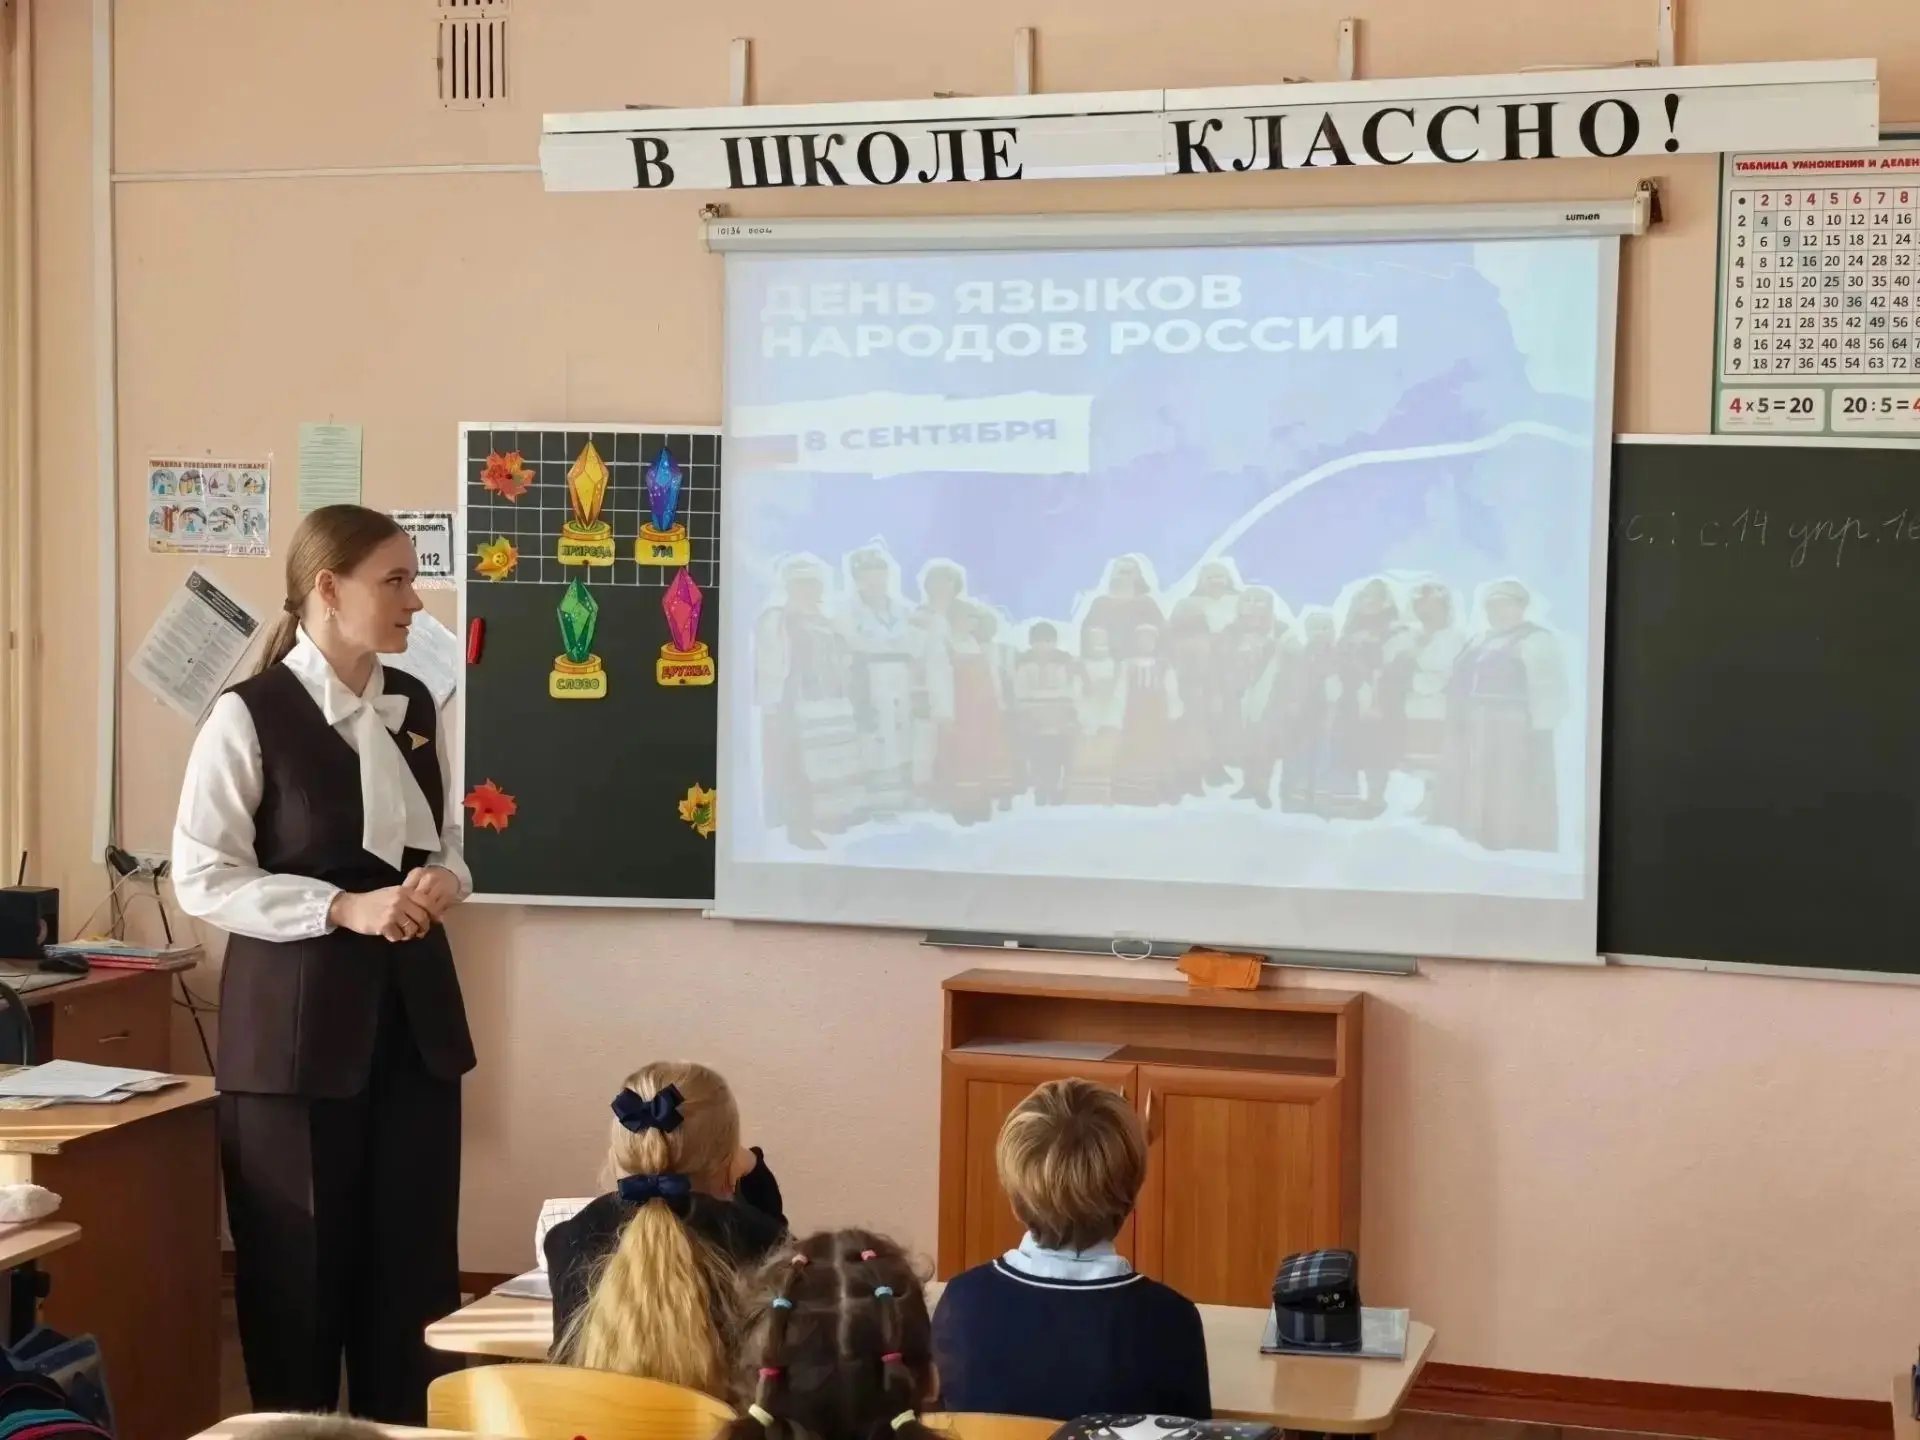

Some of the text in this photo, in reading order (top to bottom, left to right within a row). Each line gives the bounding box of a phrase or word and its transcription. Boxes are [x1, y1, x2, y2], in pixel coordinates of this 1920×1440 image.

[626, 92, 1682, 190] В ШКОЛЕ КЛАССНО!
[1735, 161, 1789, 171] ТАБЛИЦА
[1792, 159, 1865, 169] УМНОЖЕНИЯ
[1868, 159, 1877, 168] И
[1760, 190, 1909, 207] 2 3 4 5 6 7 8
[1737, 213, 1912, 227] 2 4 6 8 10 12 14 16
[1737, 233, 1911, 248] 3 6 9 12 15 18 21 24
[1735, 254, 1910, 269] 4 8 12 16 20 24 28 32
[1735, 275, 1910, 289] 5 10 15 20 25 30 35 40
[760, 274, 1243, 322] ДЕНЬ ЯЗЫКОВ
[1735, 295, 1909, 309] 6 12 18 24 30 36 42 48
[1735, 316, 1744, 330] 7
[1754, 318, 1769, 329] 14
[1776, 317, 1791, 329] 21
[1799, 317, 1815, 328] 28
[1822, 316, 1838, 328] 35
[1845, 316, 1862, 328] 42
[1869, 316, 1885, 328] 49
[1893, 316, 1908, 328] 56
[762, 314, 1399, 363] НАРОДОВ РОССИИ
[1733, 337, 1742, 350] 8
[1753, 338, 1769, 351] 16
[1775, 338, 1792, 350] 24
[1798, 338, 1814, 350] 32
[1821, 337, 1838, 349] 40
[1844, 337, 1861, 349] 48
[1868, 337, 1885, 350] 56
[1891, 337, 1908, 349] 64
[1732, 357, 1742, 370] 9
[1753, 358, 1768, 369] 18
[1775, 357, 1791, 369] 27
[1798, 357, 1814, 369] 36
[1821, 357, 1837, 369] 45
[1844, 357, 1860, 369] 54
[1868, 357, 1884, 369] 63
[1891, 357, 1907, 369] 72
[803, 418, 1059, 453] 8 СЕНТЯБРЯ
[416, 524, 446, 532] ЗВОНИТЬ
[561, 545, 613, 560] ПРИРОДА
[652, 545, 673, 558] УМ
[420, 552, 440, 566] 112
[662, 665, 711, 680] ДРУЖБА
[556, 678, 600, 690] СЛОВО
